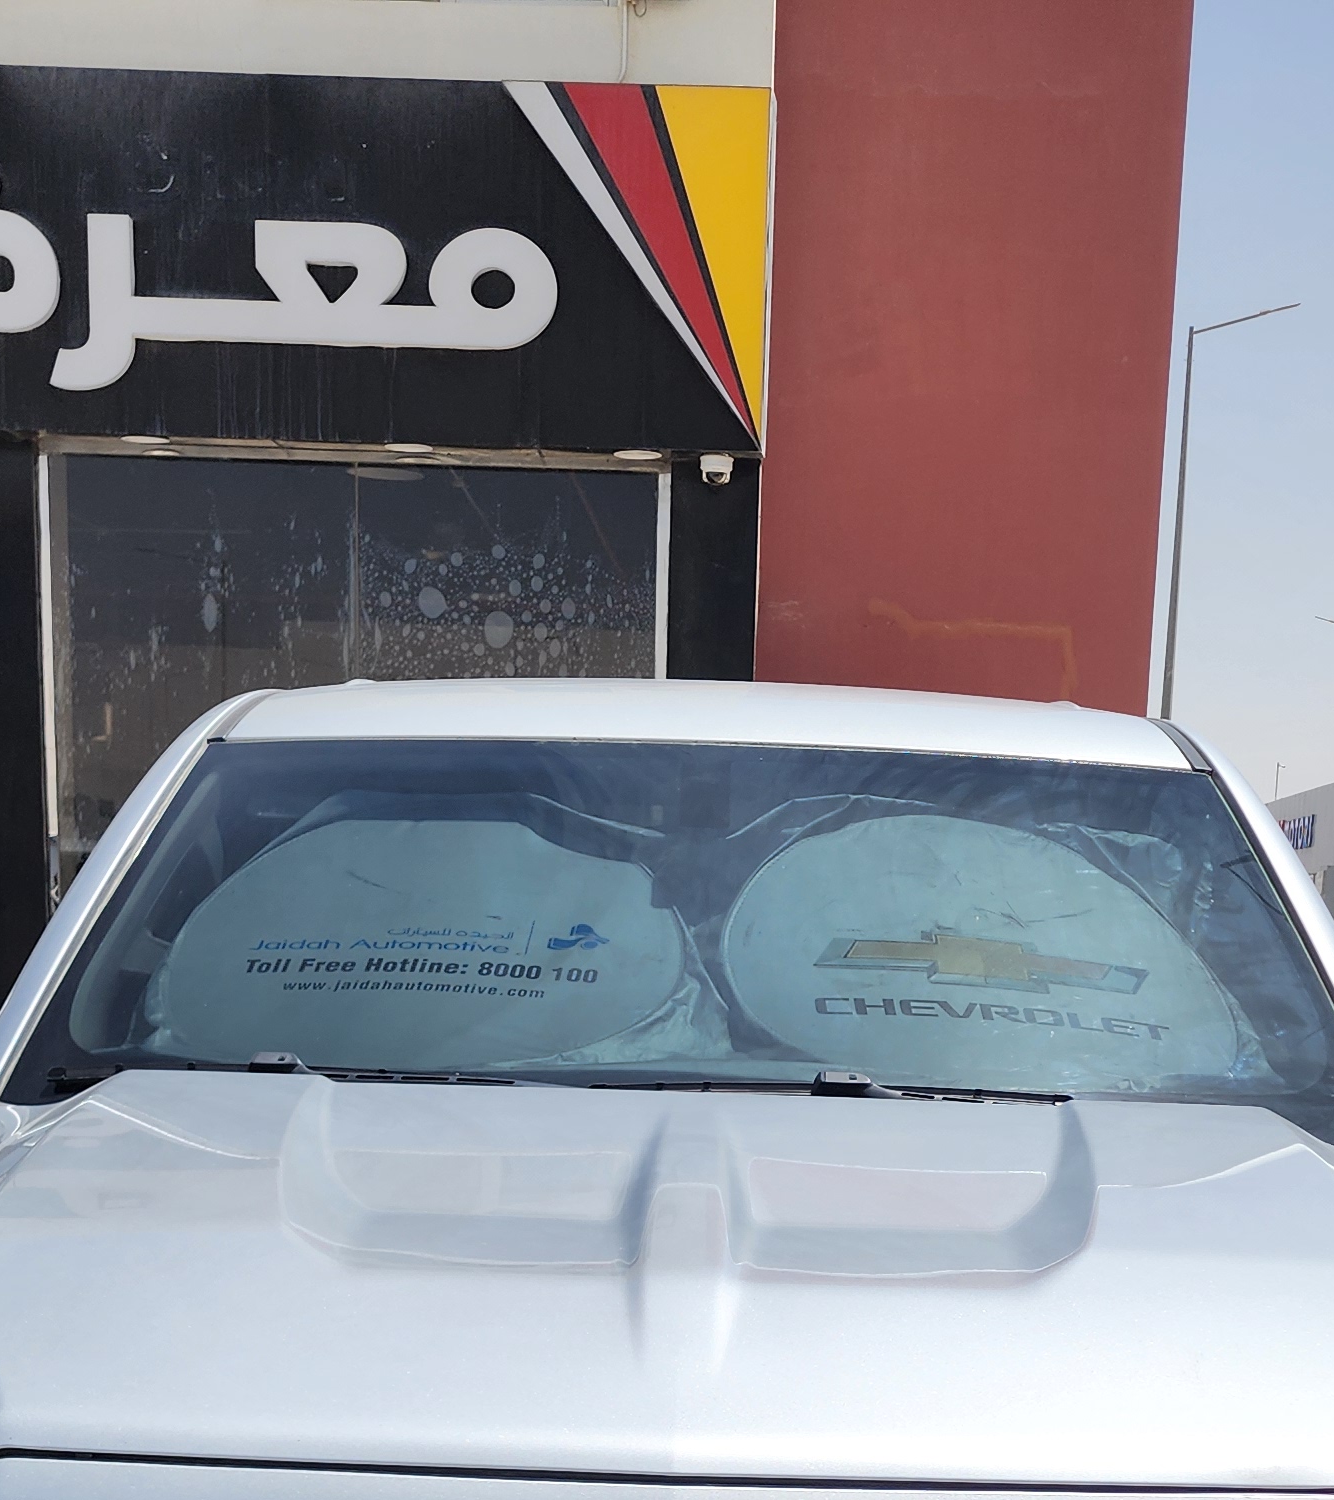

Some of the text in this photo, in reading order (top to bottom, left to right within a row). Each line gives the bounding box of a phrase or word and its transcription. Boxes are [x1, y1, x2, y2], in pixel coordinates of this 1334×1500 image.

[248, 938, 510, 955] Jaidah Automotive
[246, 957, 598, 984] Toll Free Hotline: 8000 100
[282, 979, 545, 999] www.jaidahautomotive.com
[814, 996, 1170, 1041] CHEVROLET
